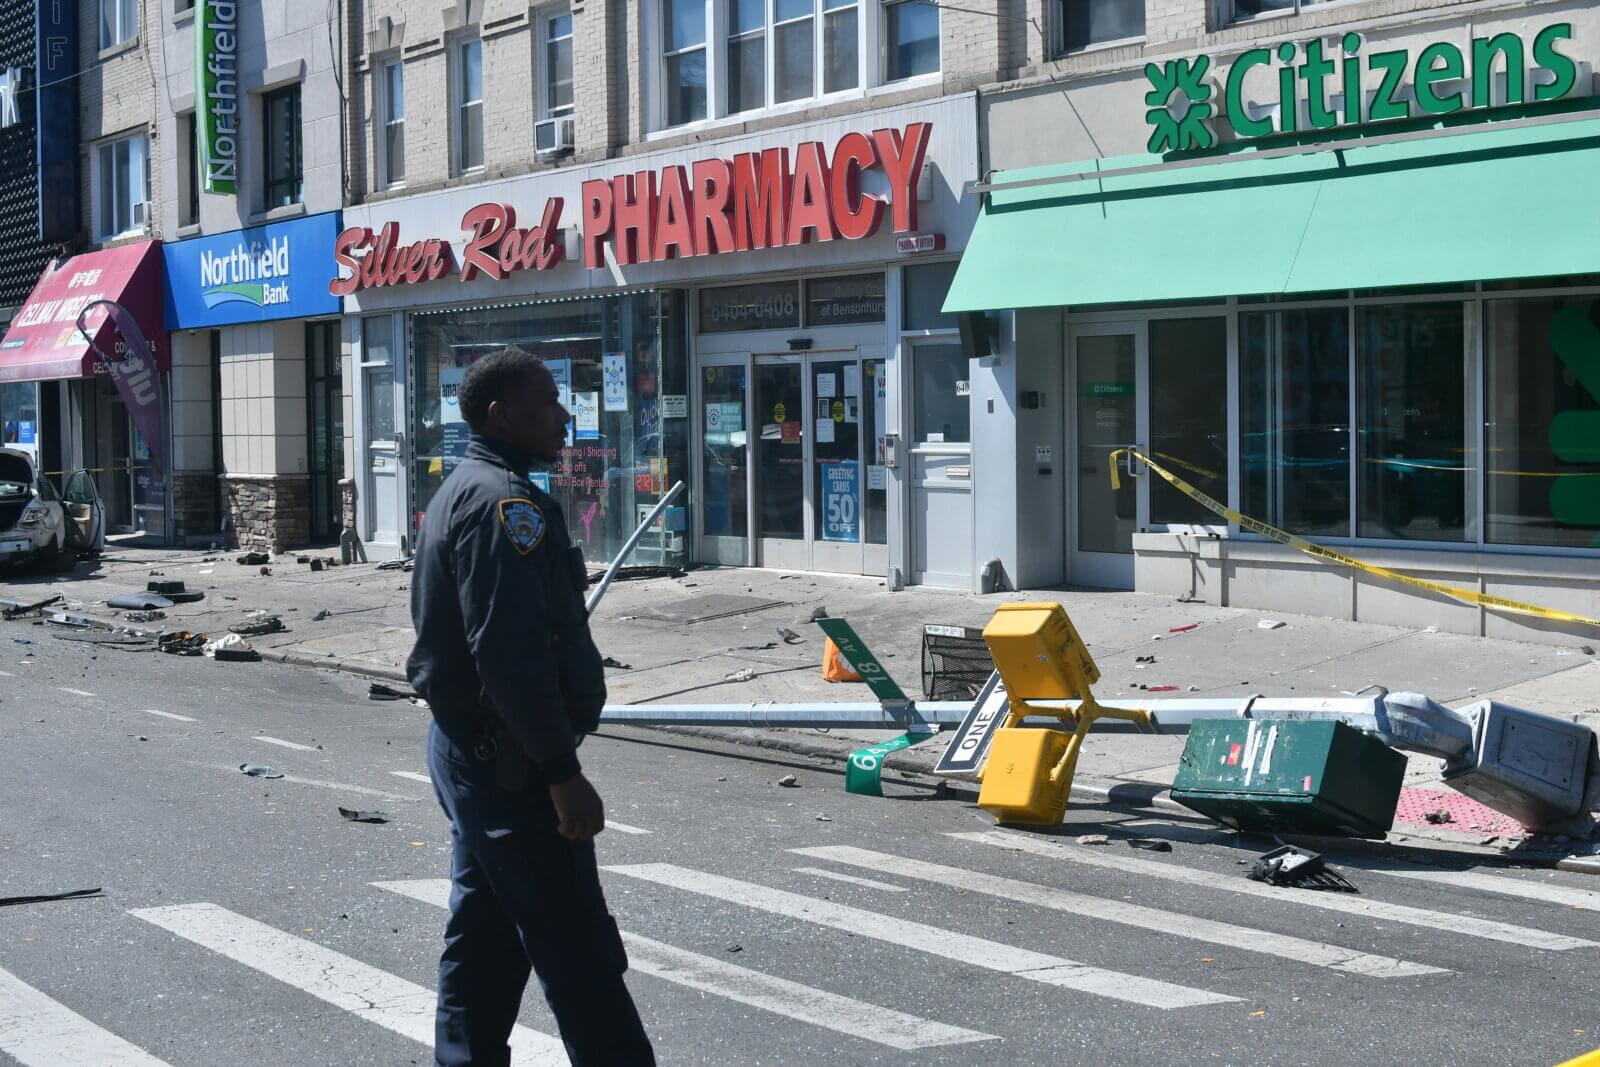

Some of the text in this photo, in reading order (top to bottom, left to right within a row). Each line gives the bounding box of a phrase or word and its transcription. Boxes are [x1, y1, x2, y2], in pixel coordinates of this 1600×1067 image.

[206, 1, 238, 181] Northfield
[1225, 22, 1578, 138] Citizens
[329, 122, 931, 297] Silver Rod PHARMACY
[201, 236, 290, 288] Northfield
[263, 281, 290, 307] Bank
[821, 304, 832, 318] of
[587, 446, 617, 460] Shipping
[827, 467, 855, 481] GREETING
[832, 480, 851, 493] CARDS
[1253, 520, 1266, 534] SCENE
[857, 661, 888, 685] 18
[961, 711, 996, 751] ONE
